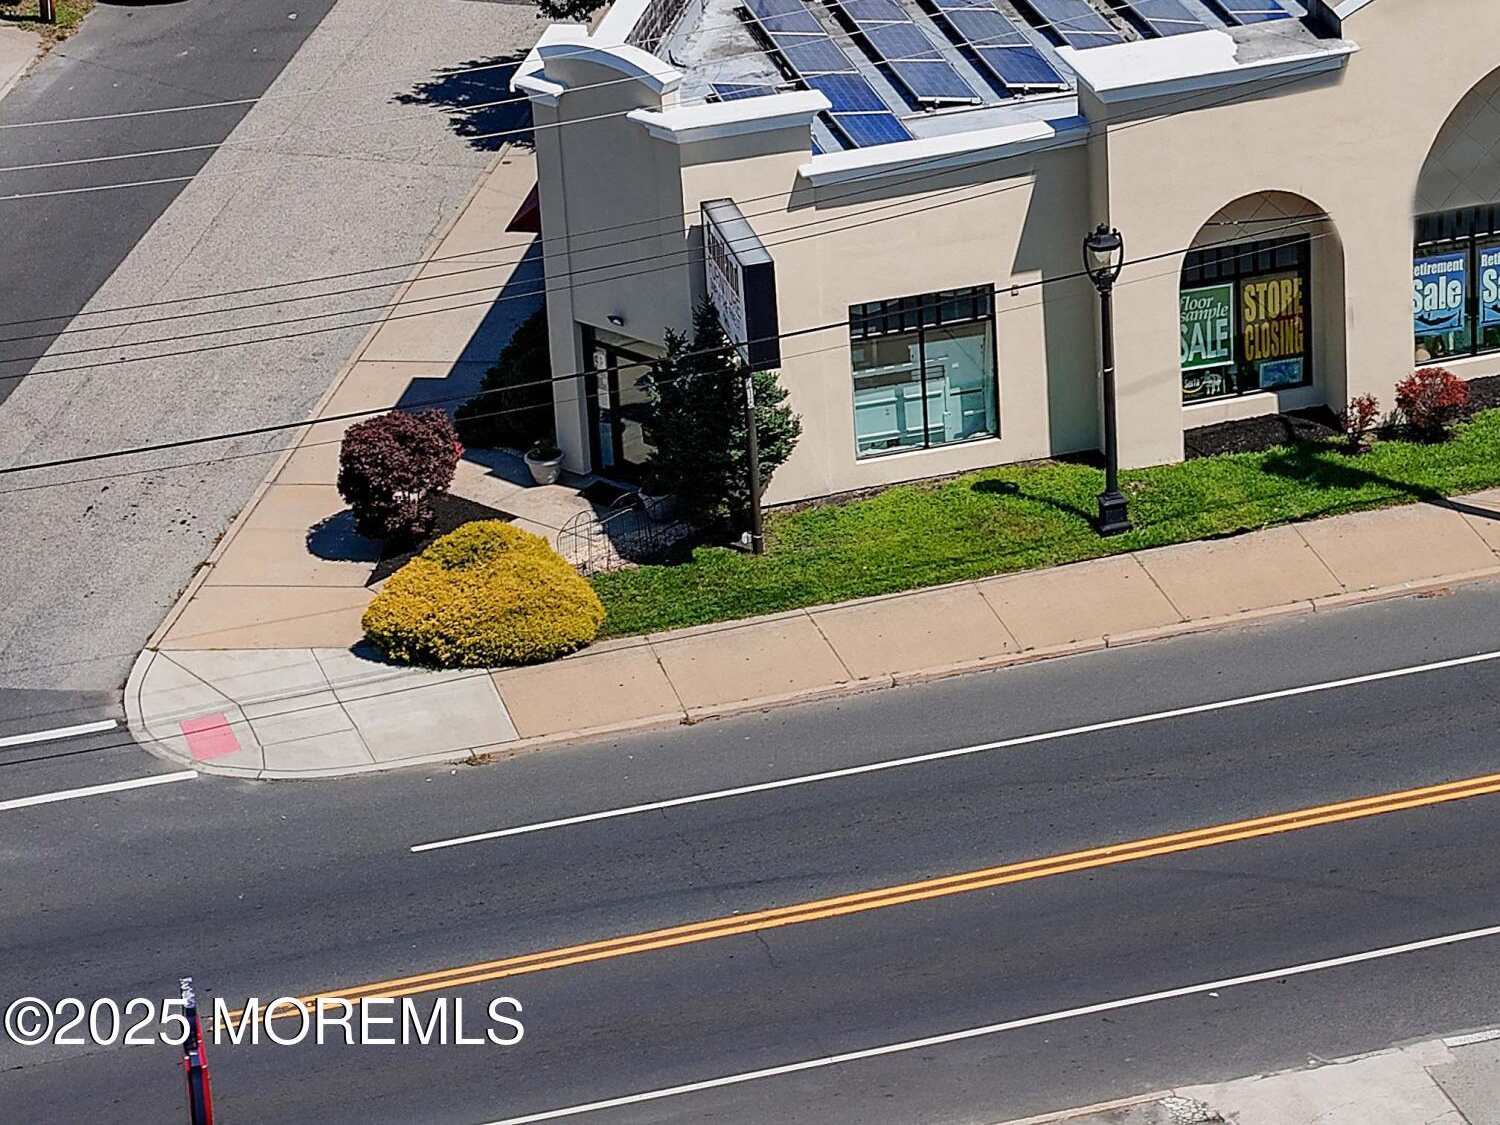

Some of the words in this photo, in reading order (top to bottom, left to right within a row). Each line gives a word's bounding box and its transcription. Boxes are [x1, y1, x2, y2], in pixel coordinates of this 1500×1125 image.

[1414, 259, 1464, 276] etirement
[1180, 302, 1229, 323] sample
[1244, 278, 1303, 322] STORE
[1244, 317, 1304, 362] CLOSING
